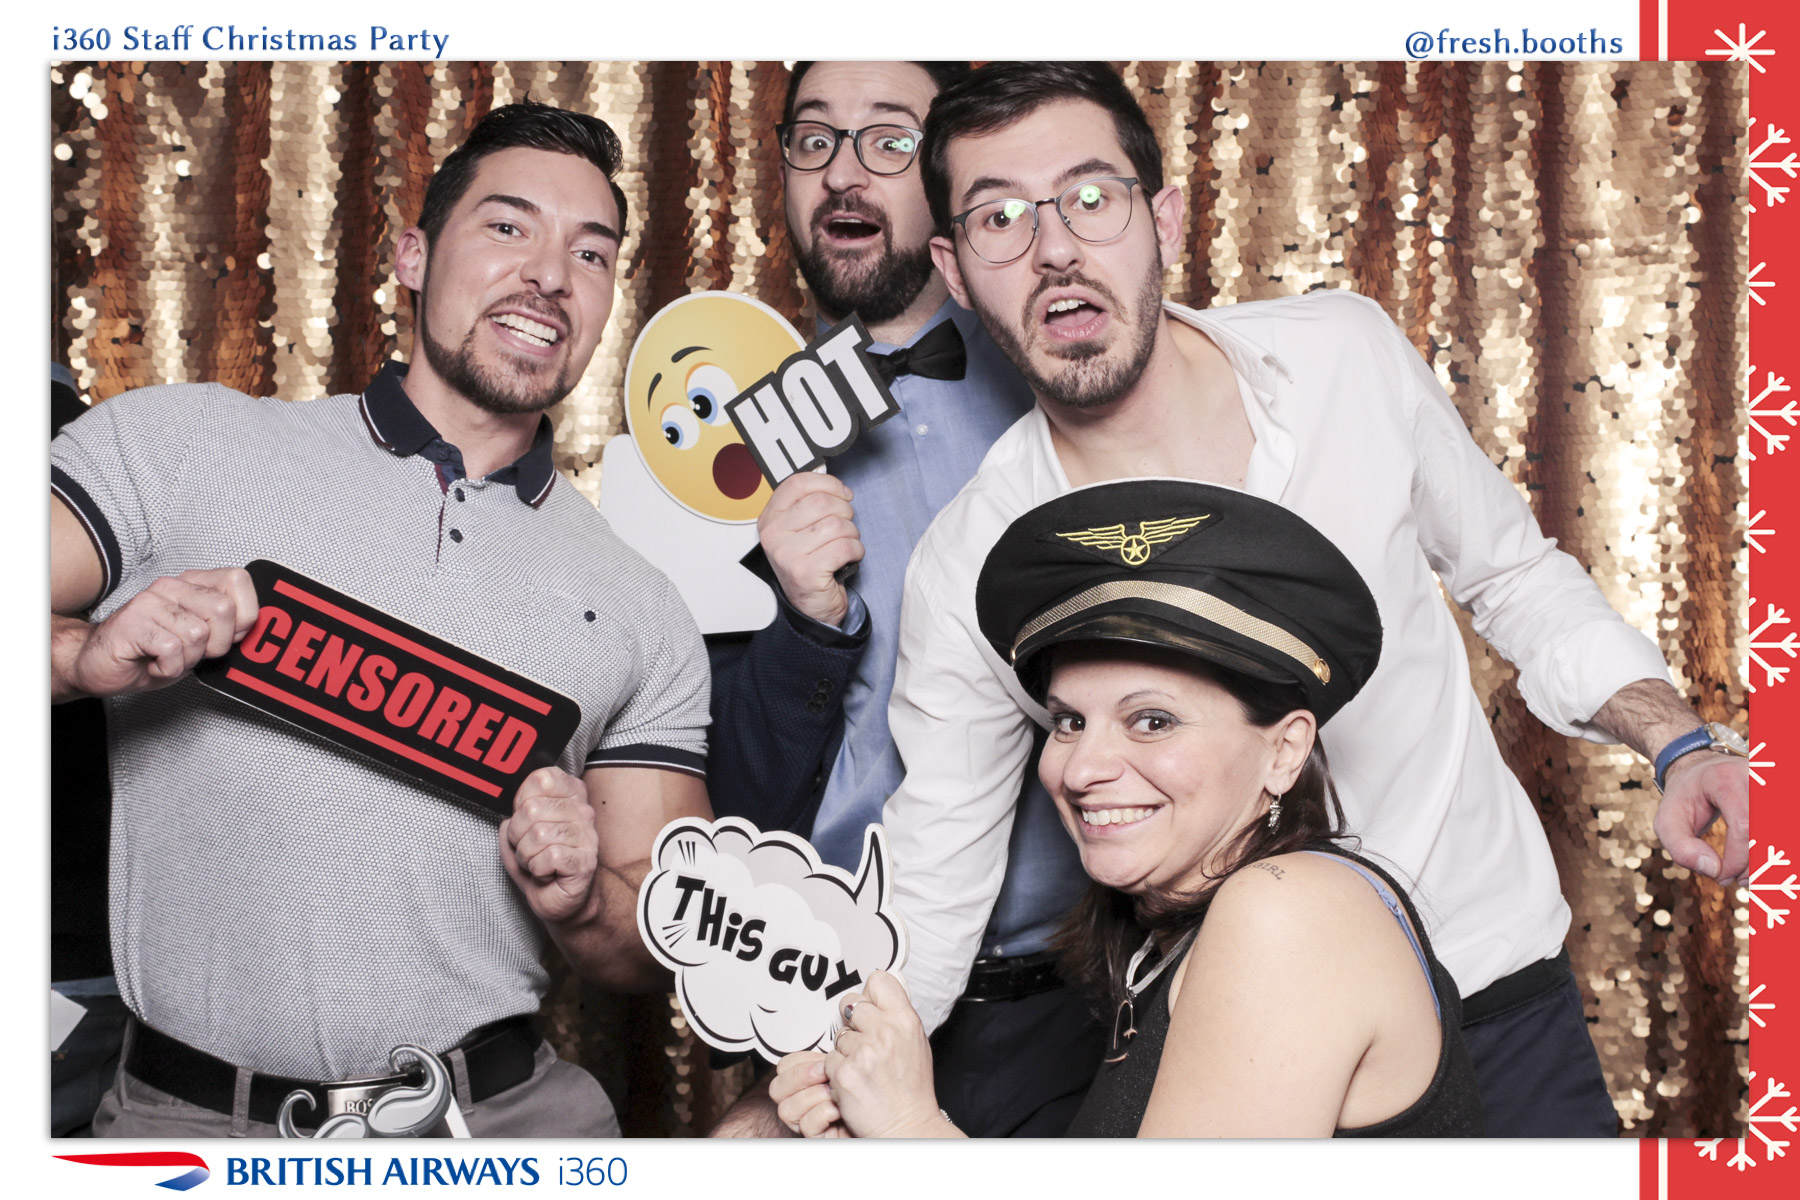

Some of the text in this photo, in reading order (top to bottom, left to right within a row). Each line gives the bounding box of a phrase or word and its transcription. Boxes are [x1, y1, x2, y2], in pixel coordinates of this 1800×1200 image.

[733, 324, 889, 484] HOT
[240, 605, 538, 774] CENSORED
[769, 948, 862, 1001] GUY
